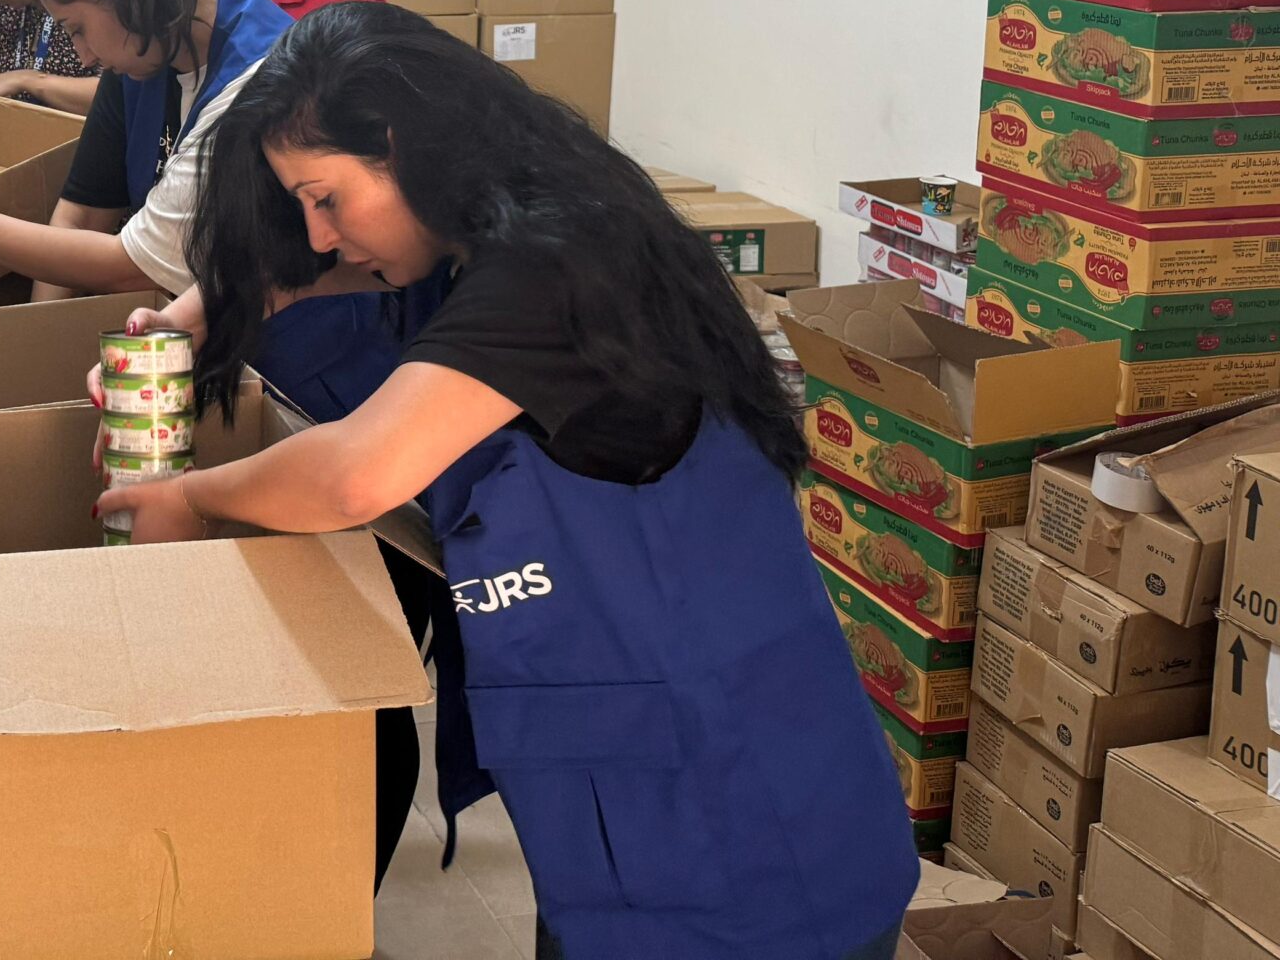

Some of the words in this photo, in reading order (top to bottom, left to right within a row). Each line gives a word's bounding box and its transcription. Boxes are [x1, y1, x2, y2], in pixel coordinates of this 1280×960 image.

[44, 16, 54, 35] JRS
[33, 57, 43, 70] RS
[1012, 63, 1029, 73] Chunks
[1086, 84, 1111, 97] Skipjack
[1071, 112, 1086, 124] Tuna
[1087, 115, 1111, 129] Chunks
[1111, 235, 1125, 246] Tuna
[1094, 253, 1120, 265] ALAHLAM
[1056, 308, 1072, 322] Tuna
[1073, 314, 1096, 331] Chunks
[1146, 544, 1154, 553] 40
[1160, 549, 1175, 564] 112g
[478, 562, 552, 612] JRS
[1233, 584, 1278, 625] 400
[1091, 618, 1104, 633] 112g
[1222, 736, 1268, 778] 400
